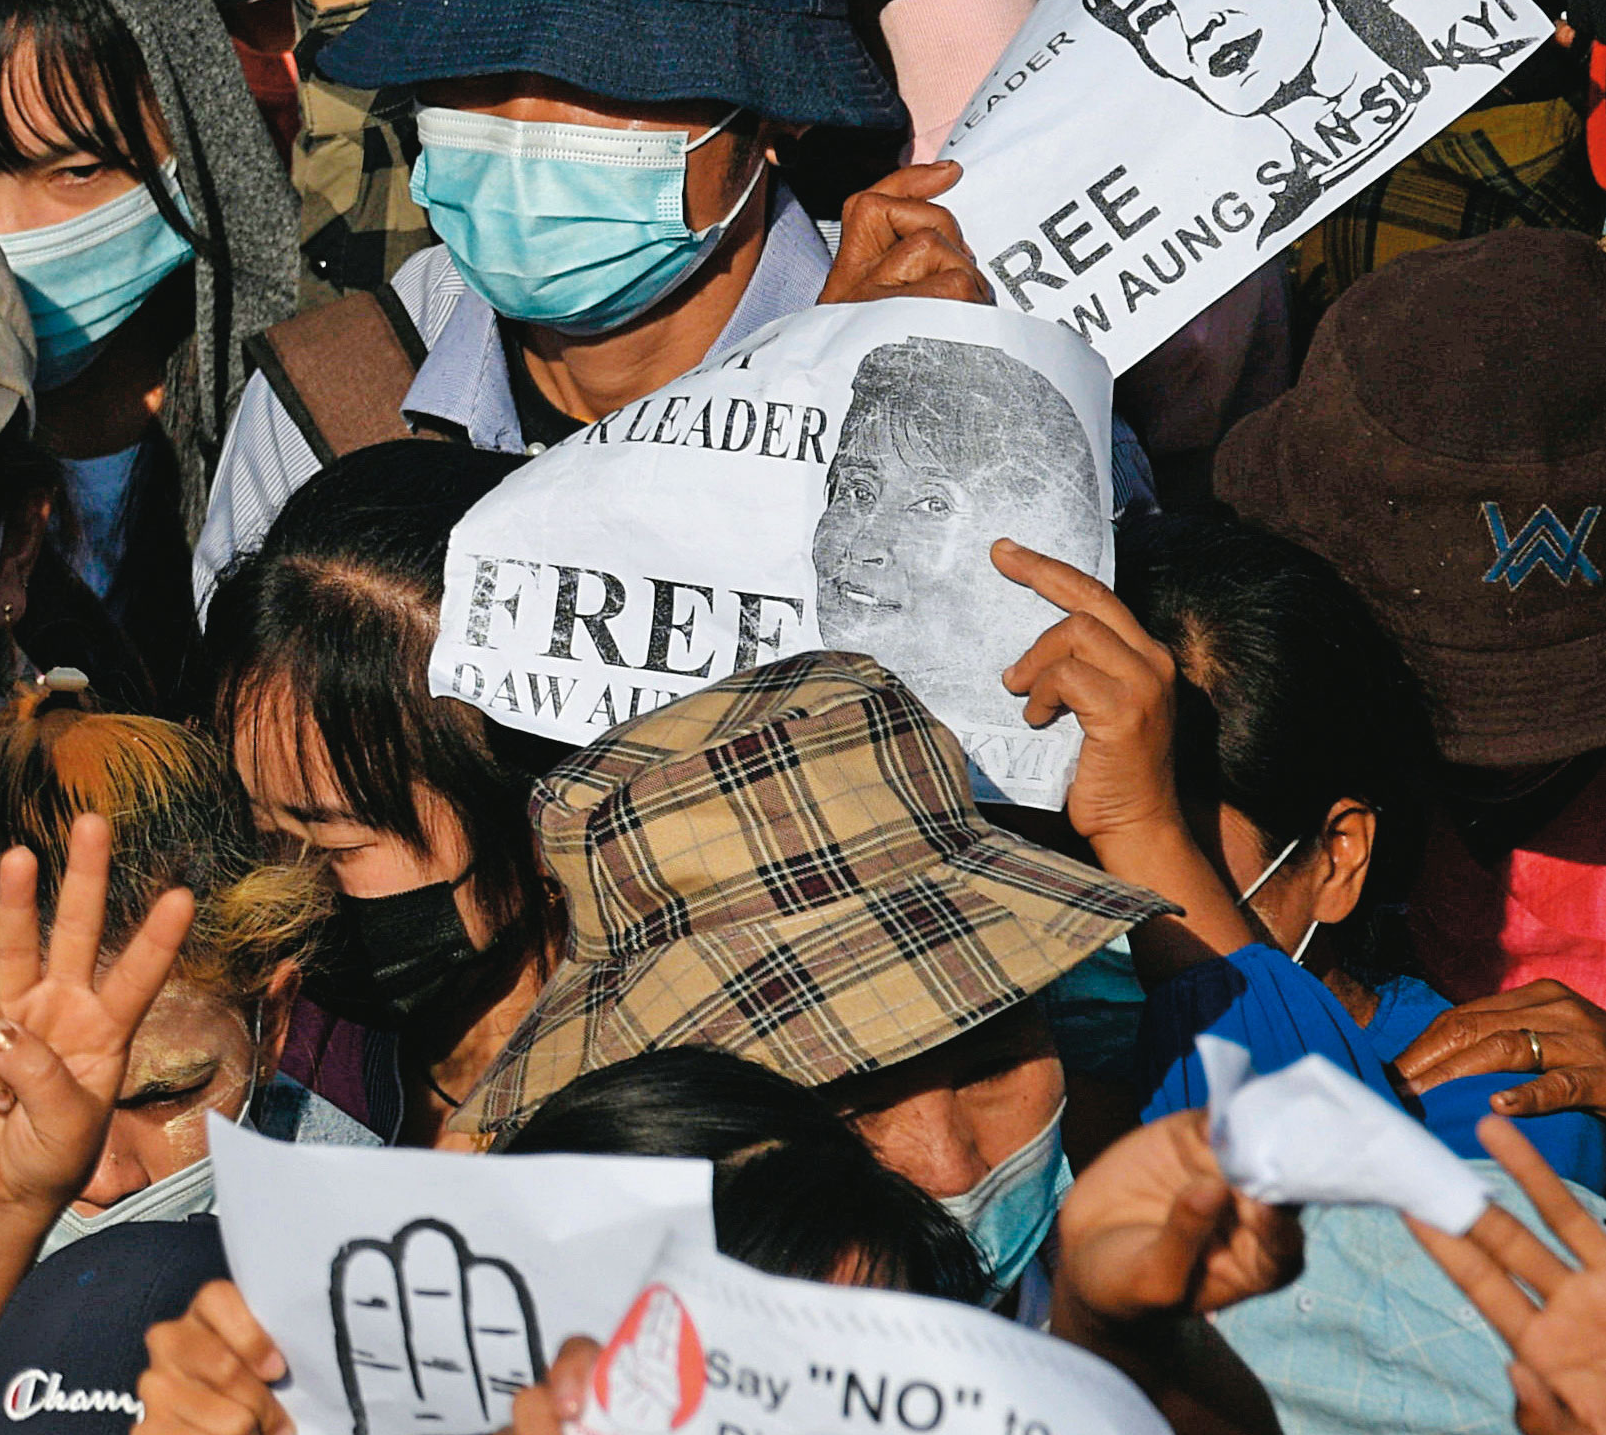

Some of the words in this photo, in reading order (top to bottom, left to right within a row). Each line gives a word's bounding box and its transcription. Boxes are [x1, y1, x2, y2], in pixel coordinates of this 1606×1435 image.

[948, 30, 1076, 147] LEADER
[988, 165, 1162, 313] REE
[1117, 191, 1255, 313] AUNG
[1255, 106, 1362, 190] SAN
[1360, 69, 1431, 124] SU
[621, 396, 831, 464] LEADER
[464, 552, 806, 679] FREE
[450, 661, 578, 724] DAW
[707, 1352, 792, 1410] Say
[810, 1365, 983, 1433] "NO"
